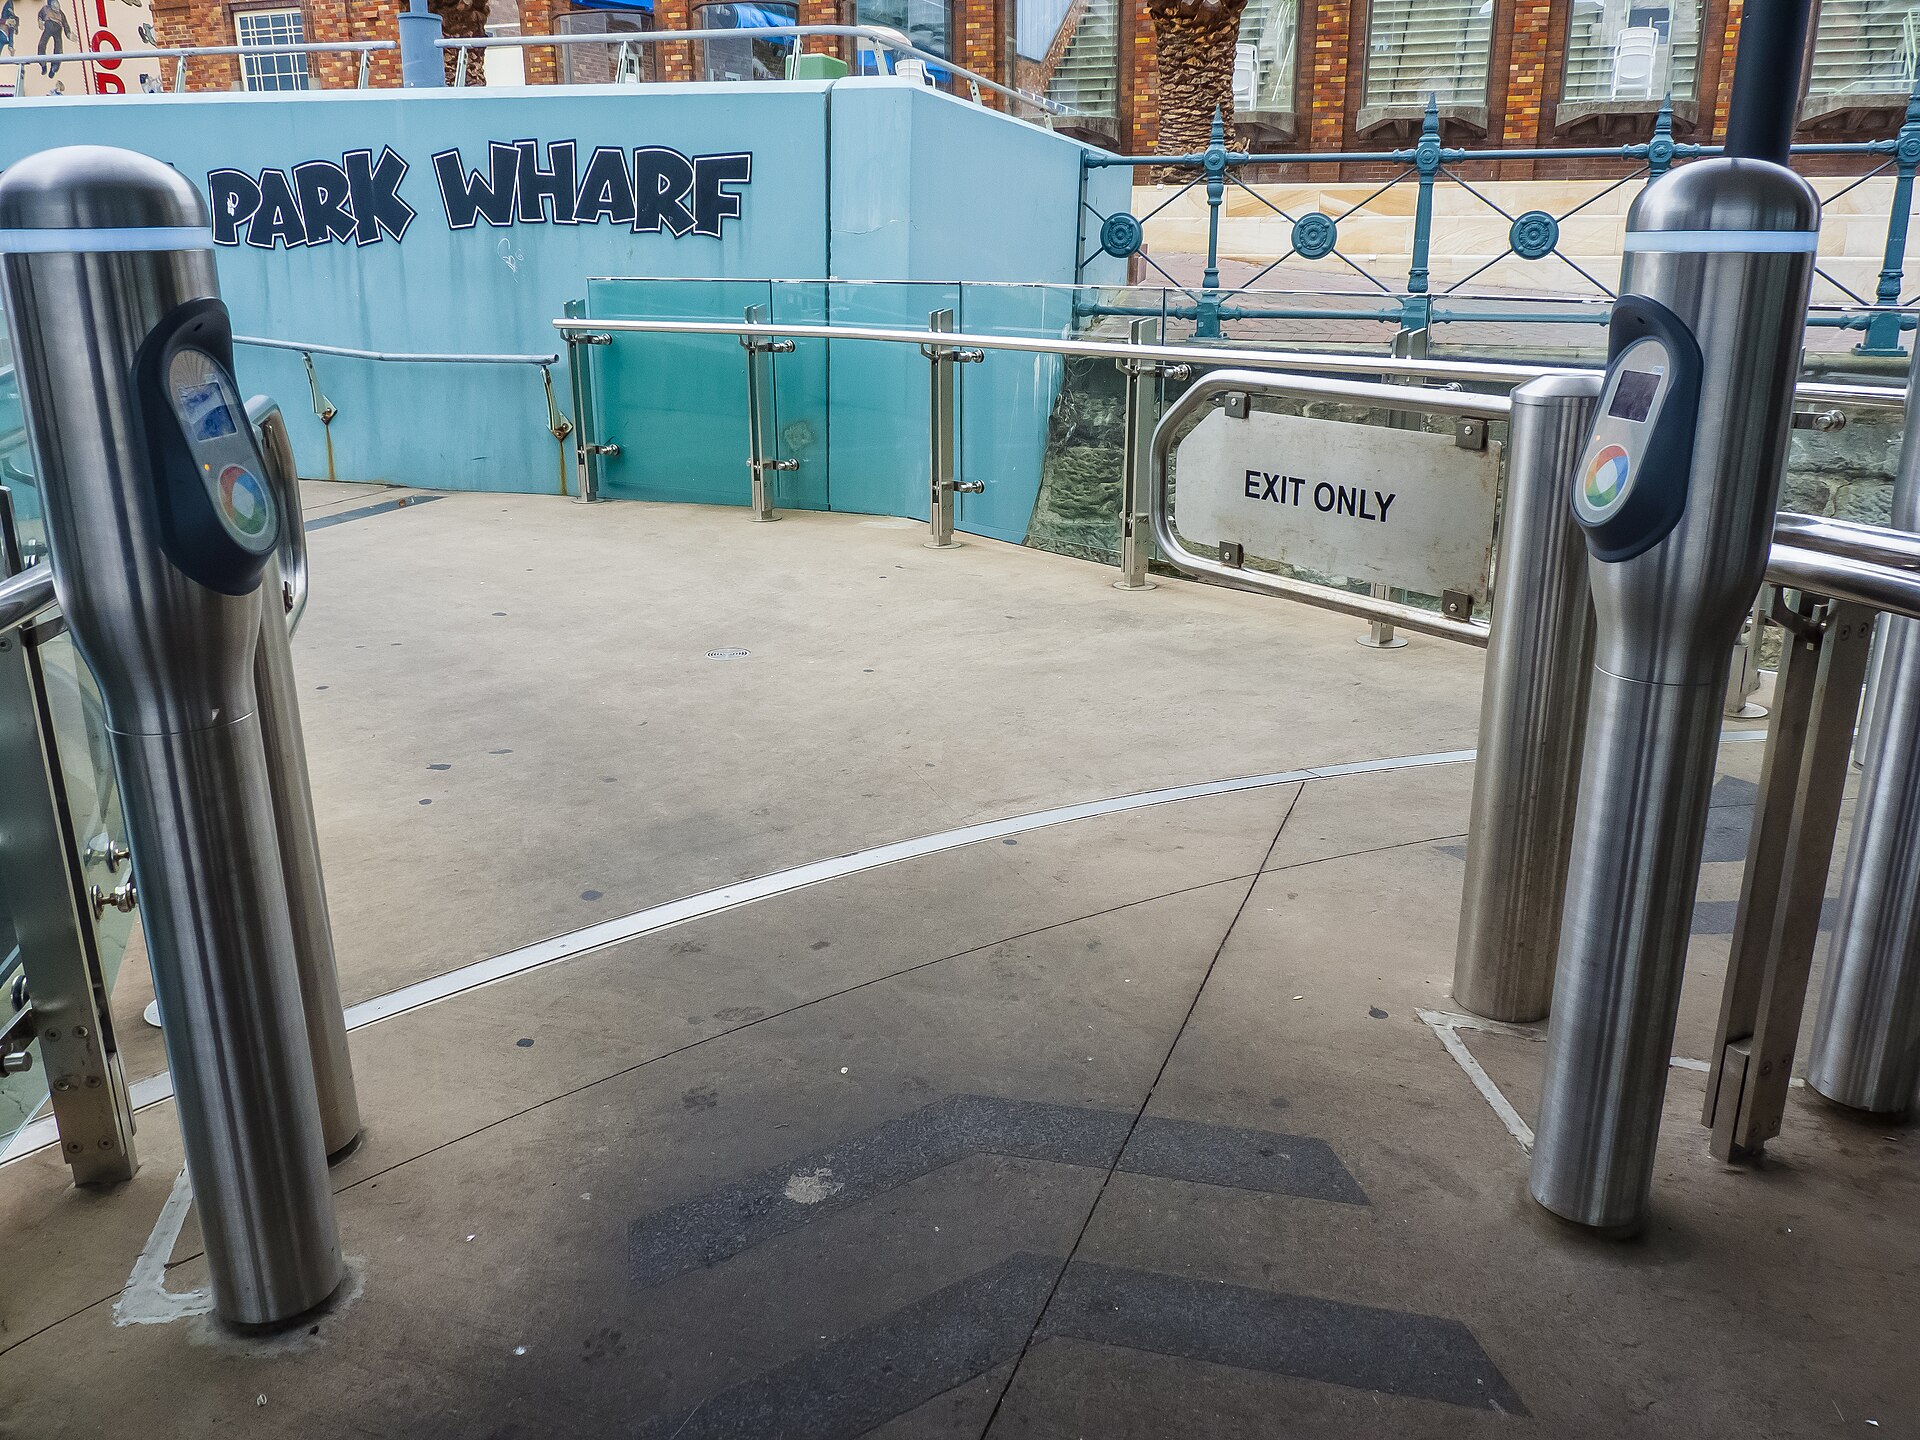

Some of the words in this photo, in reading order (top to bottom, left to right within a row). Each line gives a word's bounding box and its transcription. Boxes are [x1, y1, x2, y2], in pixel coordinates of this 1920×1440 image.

[207, 144, 418, 250] PARK
[431, 138, 753, 240] WHARF
[1244, 469, 1306, 507] EXIT
[1313, 482, 1397, 523] ONLY
